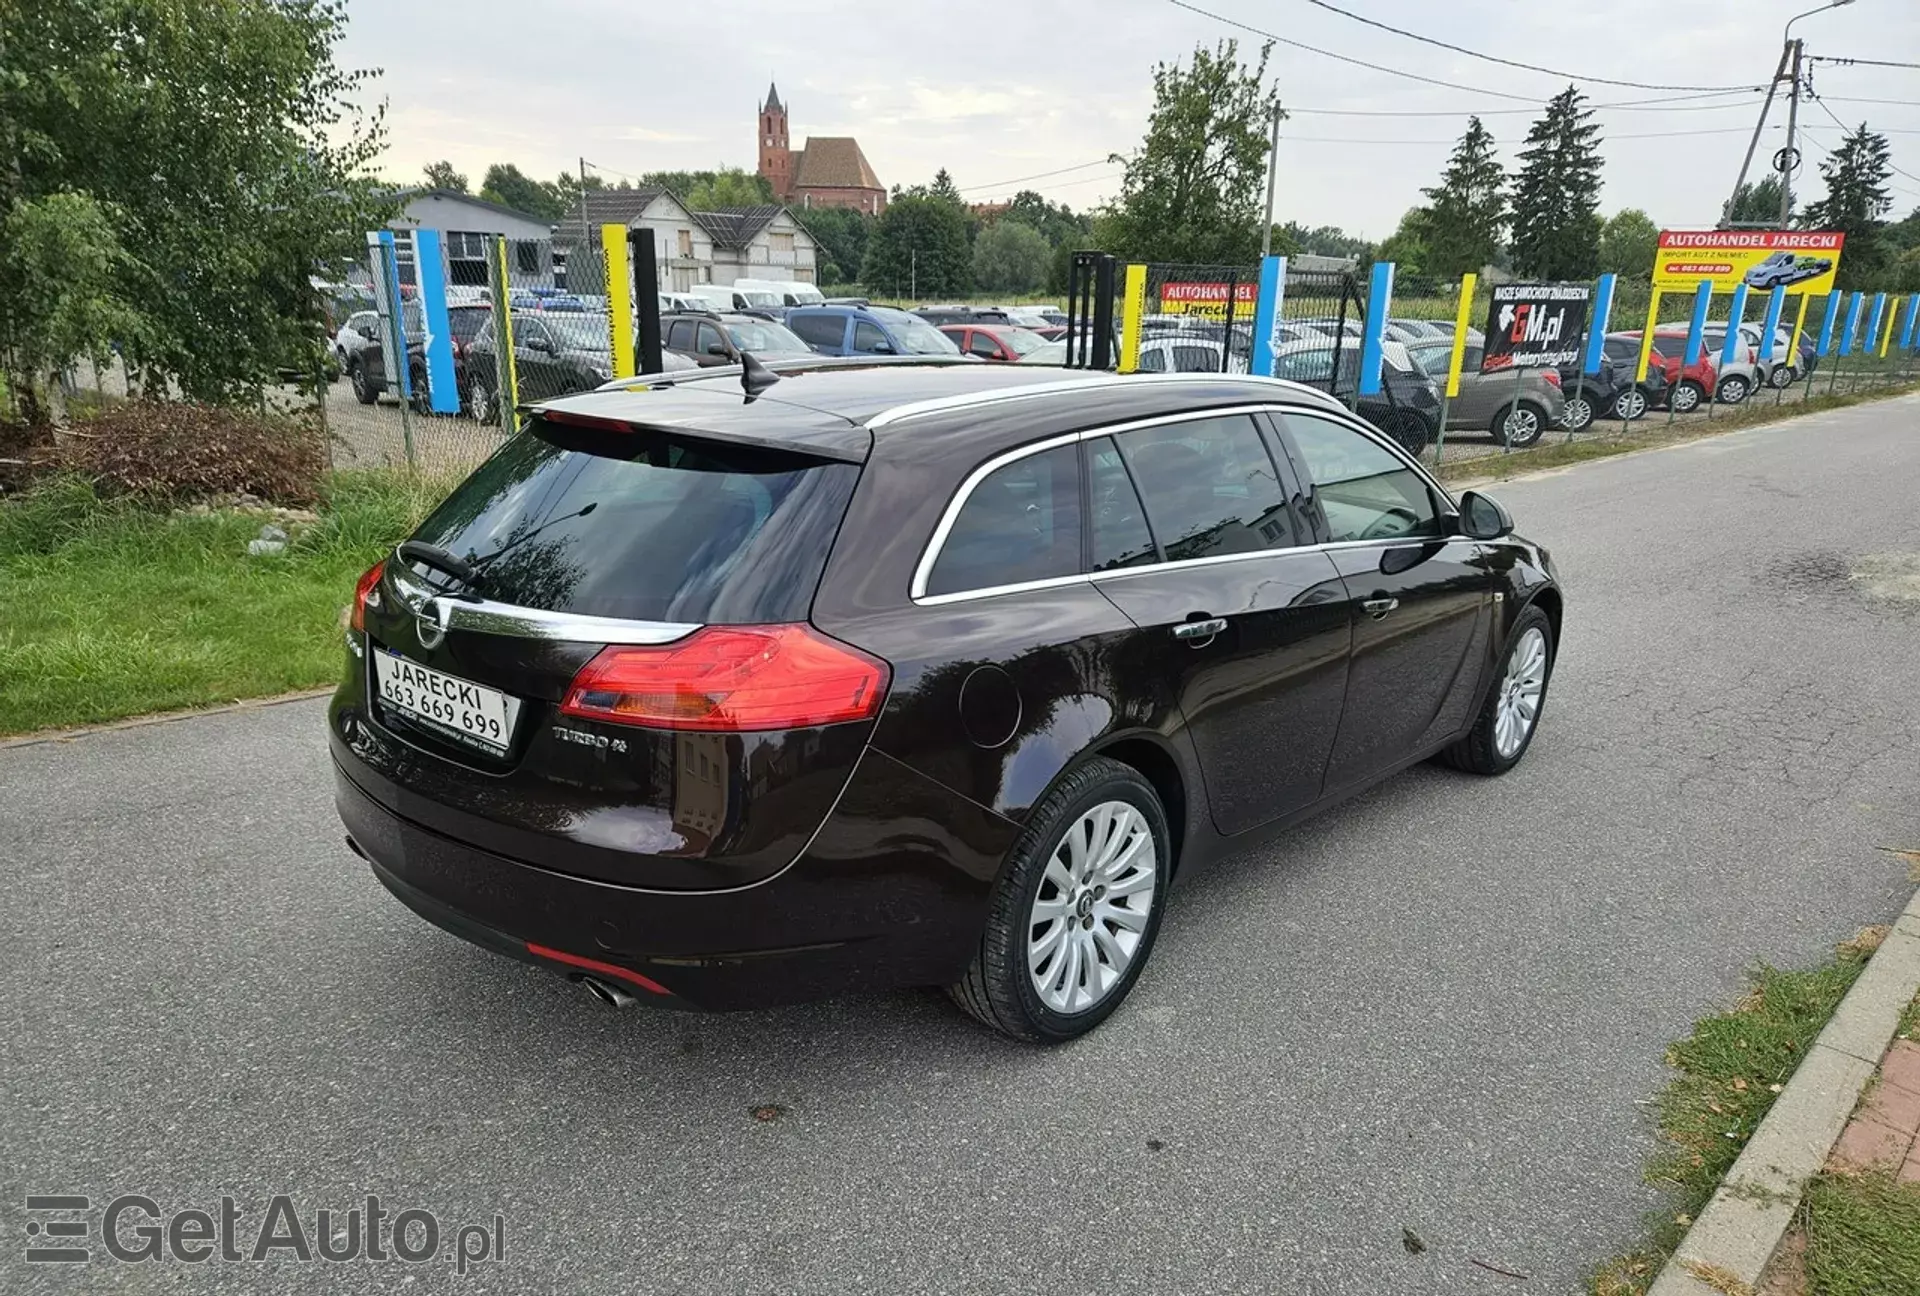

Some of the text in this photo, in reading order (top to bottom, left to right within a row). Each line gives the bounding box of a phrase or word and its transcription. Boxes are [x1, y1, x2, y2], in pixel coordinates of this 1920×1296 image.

[1666, 235, 1838, 247] AUTOHANDEL JARECKI
[1717, 252, 1749, 260] NIEMIEC
[1182, 303, 1228, 316] Jarec
[1511, 304, 1565, 350] GM.pl
[391, 660, 482, 711] JARECKI
[384, 680, 415, 707] 663
[421, 695, 454, 722] 669
[462, 710, 501, 739] 699
[552, 726, 609, 748] TURBO
